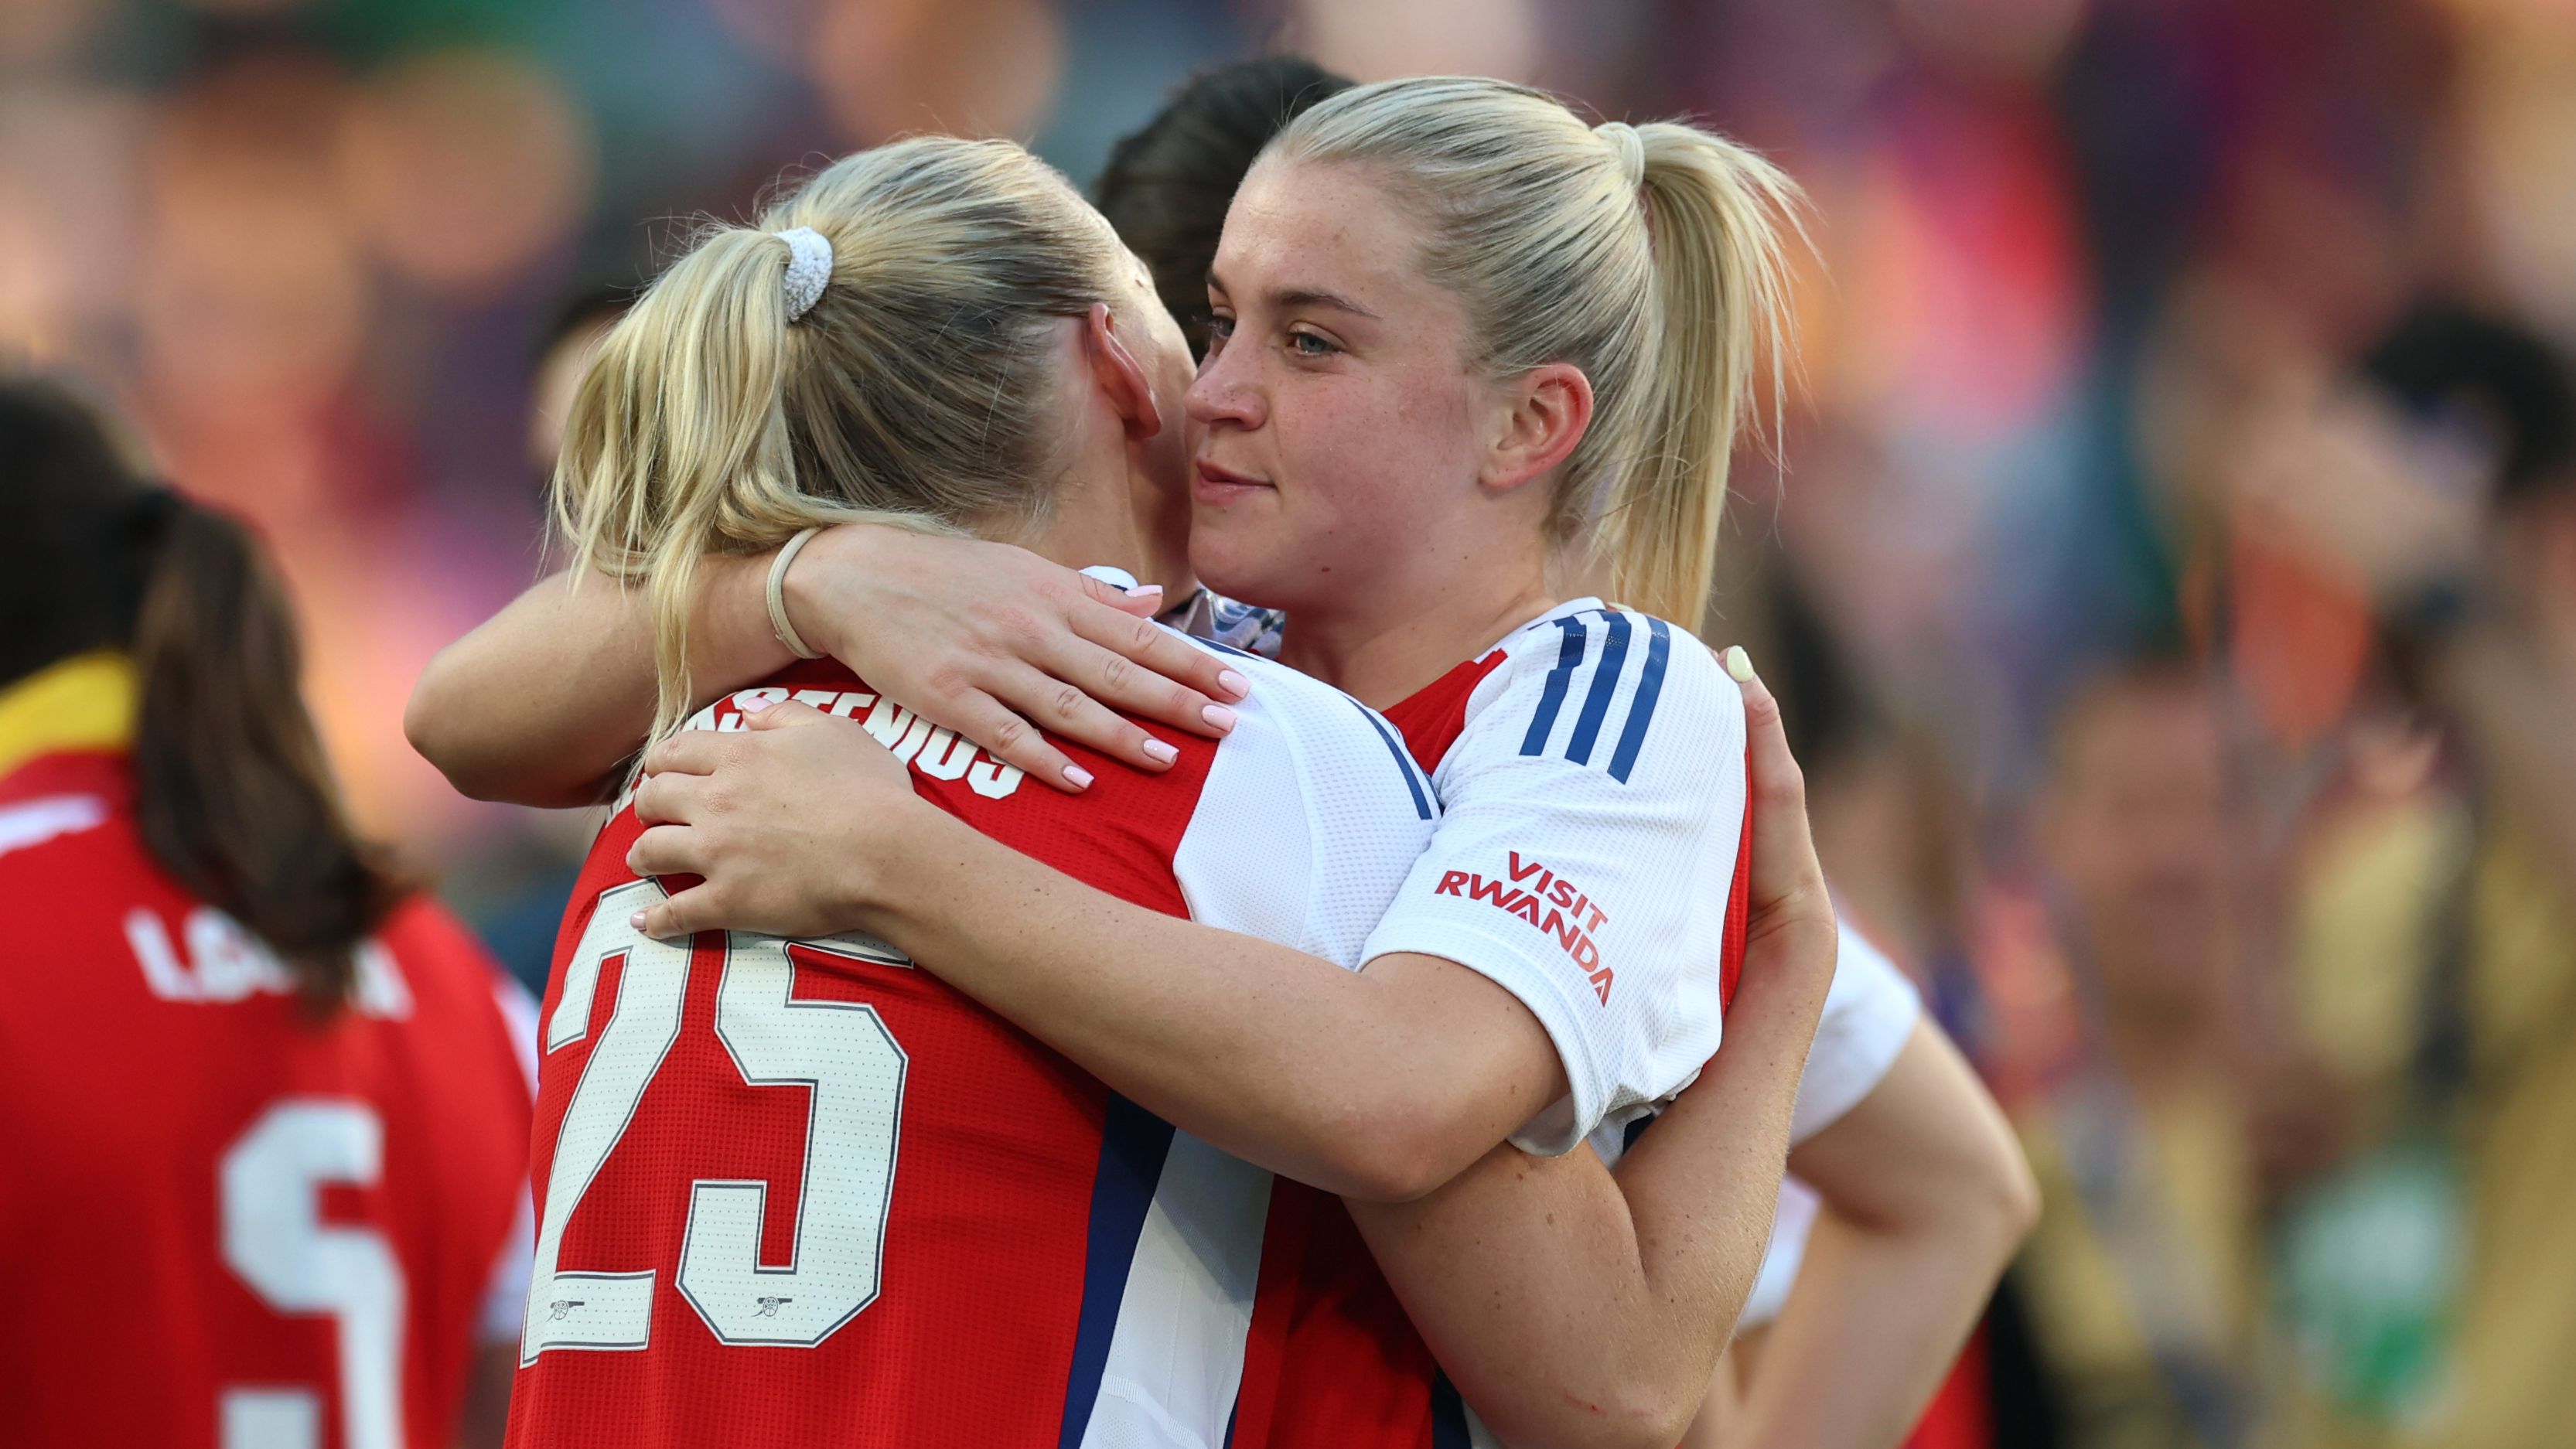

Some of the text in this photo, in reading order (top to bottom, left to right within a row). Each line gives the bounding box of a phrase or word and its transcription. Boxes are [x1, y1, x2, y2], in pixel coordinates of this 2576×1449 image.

[1435, 871, 1613, 1007] RWANDA
[1510, 851, 1609, 933] VISIT
[520, 875, 914, 1369] 25
